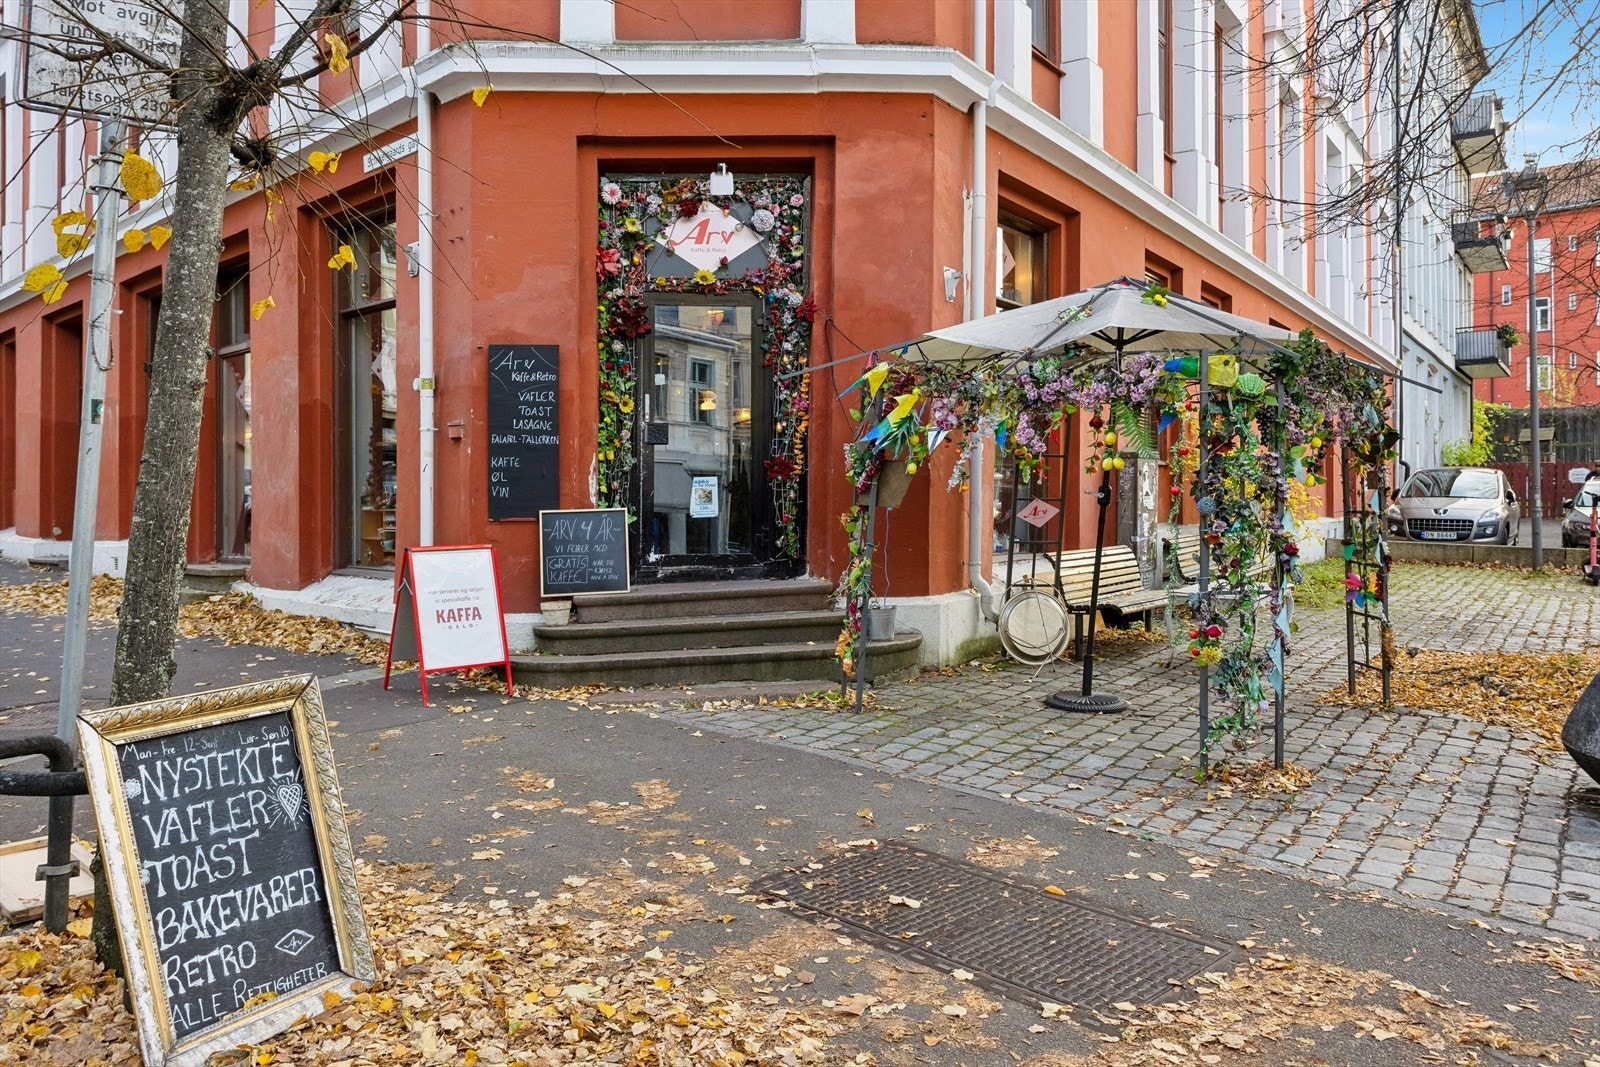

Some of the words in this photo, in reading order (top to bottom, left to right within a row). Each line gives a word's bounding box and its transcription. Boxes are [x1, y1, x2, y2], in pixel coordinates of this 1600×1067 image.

[116, 7, 169, 27] avgift
[670, 218, 735, 247] Arv
[495, 350, 535, 370] Arv
[518, 391, 556, 402] VAFLER
[518, 405, 553, 417] TOAST
[513, 418, 552, 431] LASAGNE
[491, 456, 520, 468] KAFFE
[491, 471, 507, 482] ØL
[491, 485, 509, 498] VIN
[548, 518, 578, 541] ARV
[581, 520, 593, 540] 4
[595, 514, 615, 542] ÅR
[554, 545, 564, 553] VI
[549, 556, 587, 570] GRATIS
[550, 570, 583, 583] KAFFE
[435, 606, 482, 624] KAFFA
[138, 739, 294, 805] NYSTEKTE
[141, 789, 271, 848] VAFLER
[143, 828, 260, 898] TOAST
[155, 867, 321, 951] BAKEVARER
[162, 940, 257, 999] RETRO
[173, 993, 228, 1031] ALLE
